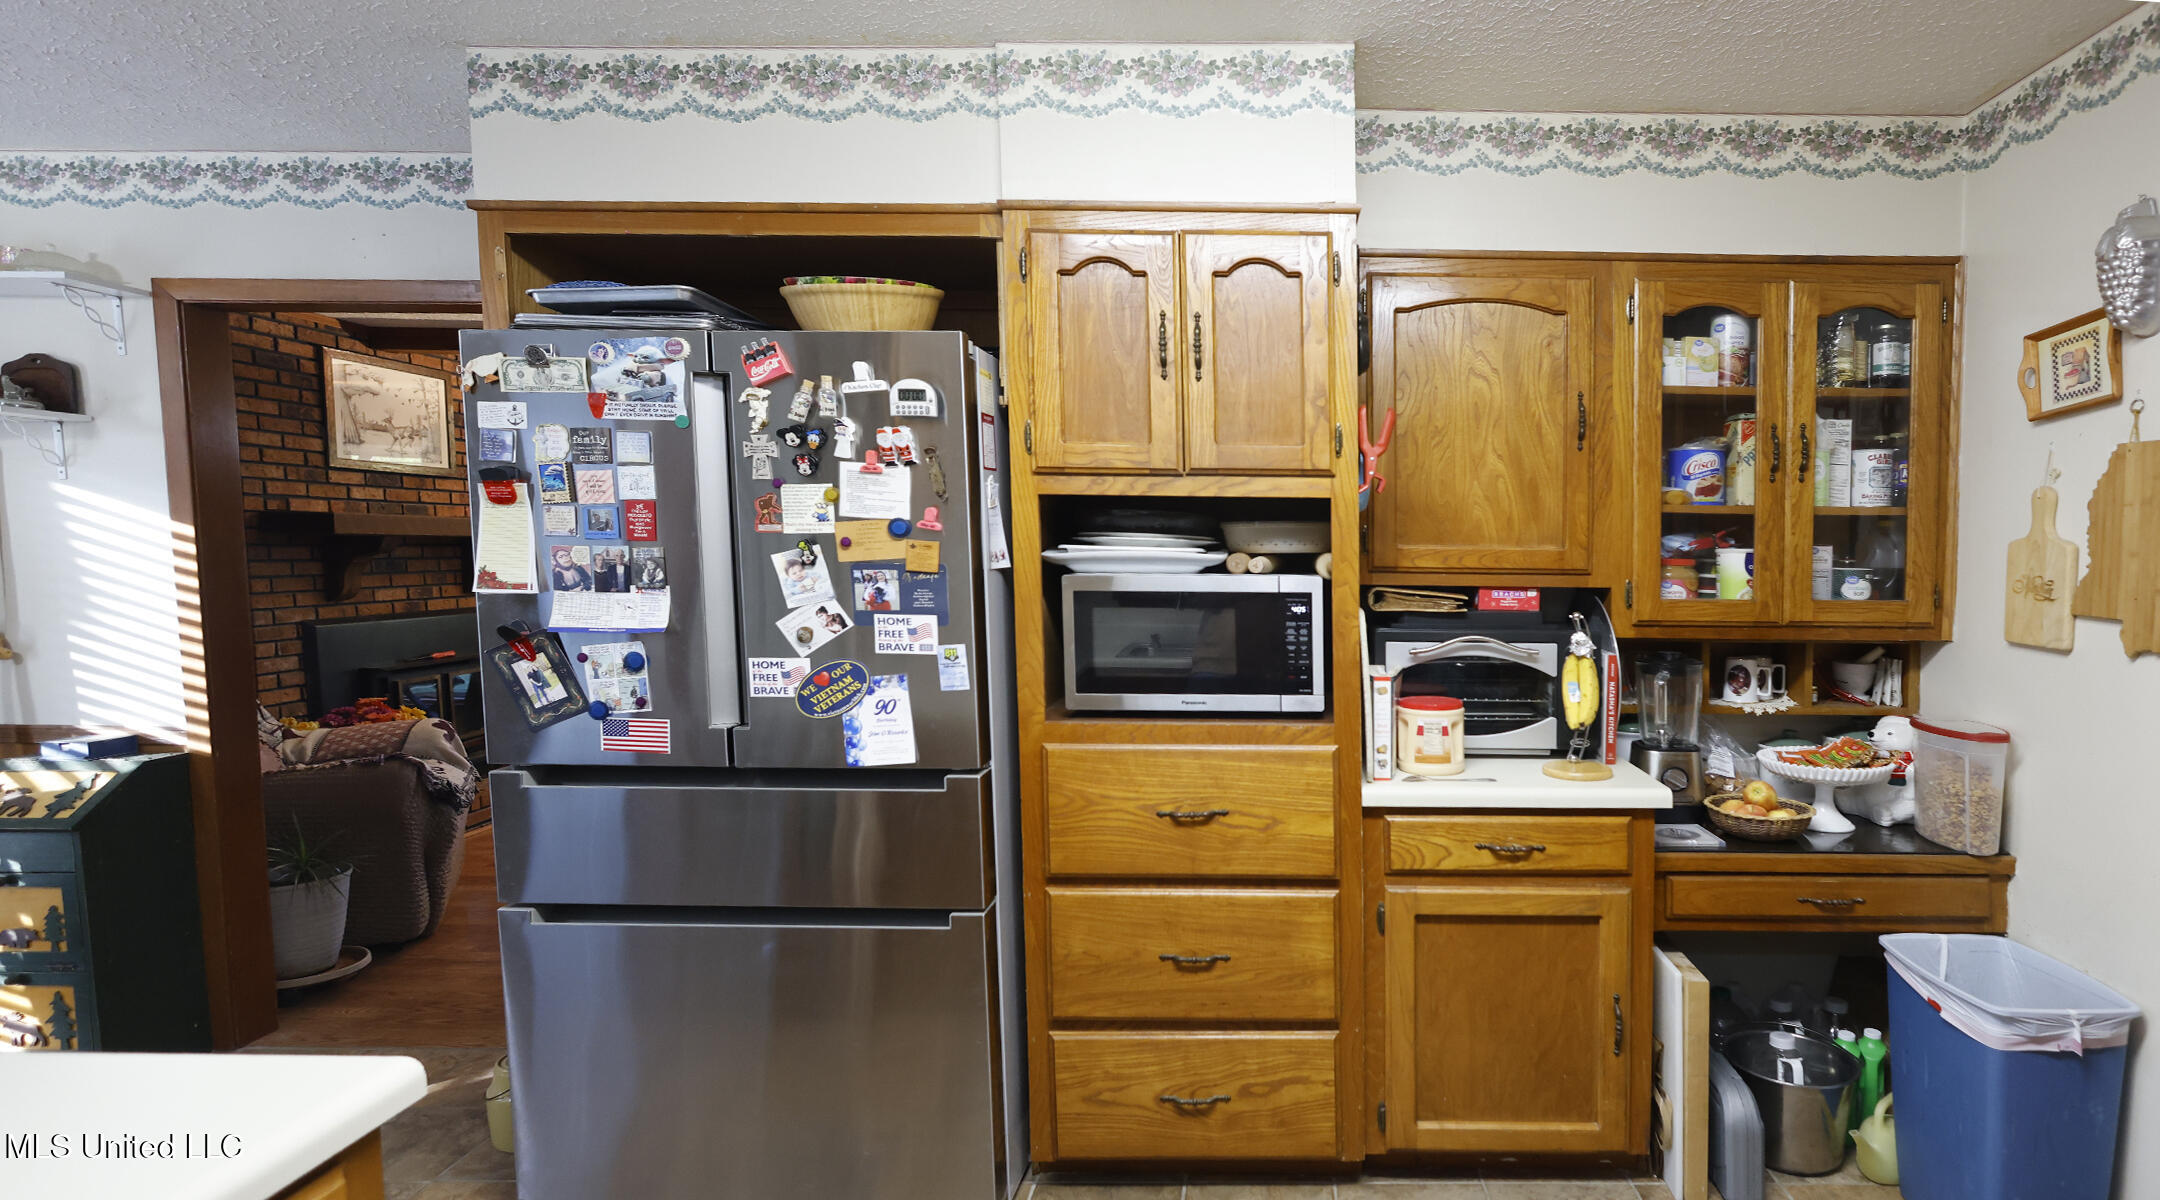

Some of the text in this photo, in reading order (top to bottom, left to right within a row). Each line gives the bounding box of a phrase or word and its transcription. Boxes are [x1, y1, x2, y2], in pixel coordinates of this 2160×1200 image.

[572, 436, 607, 446] family
[1687, 459, 1717, 476] Crisco
[877, 617, 912, 626] HOME
[878, 630, 904, 638] FREE
[878, 643, 915, 651] BRAVE
[752, 661, 786, 669] HOME
[753, 674, 778, 682] FREE
[800, 662, 853, 697] WE OUR
[753, 687, 789, 695] BRAVE
[809, 675, 854, 704] VIETNAM
[813, 681, 862, 713] VETERANS
